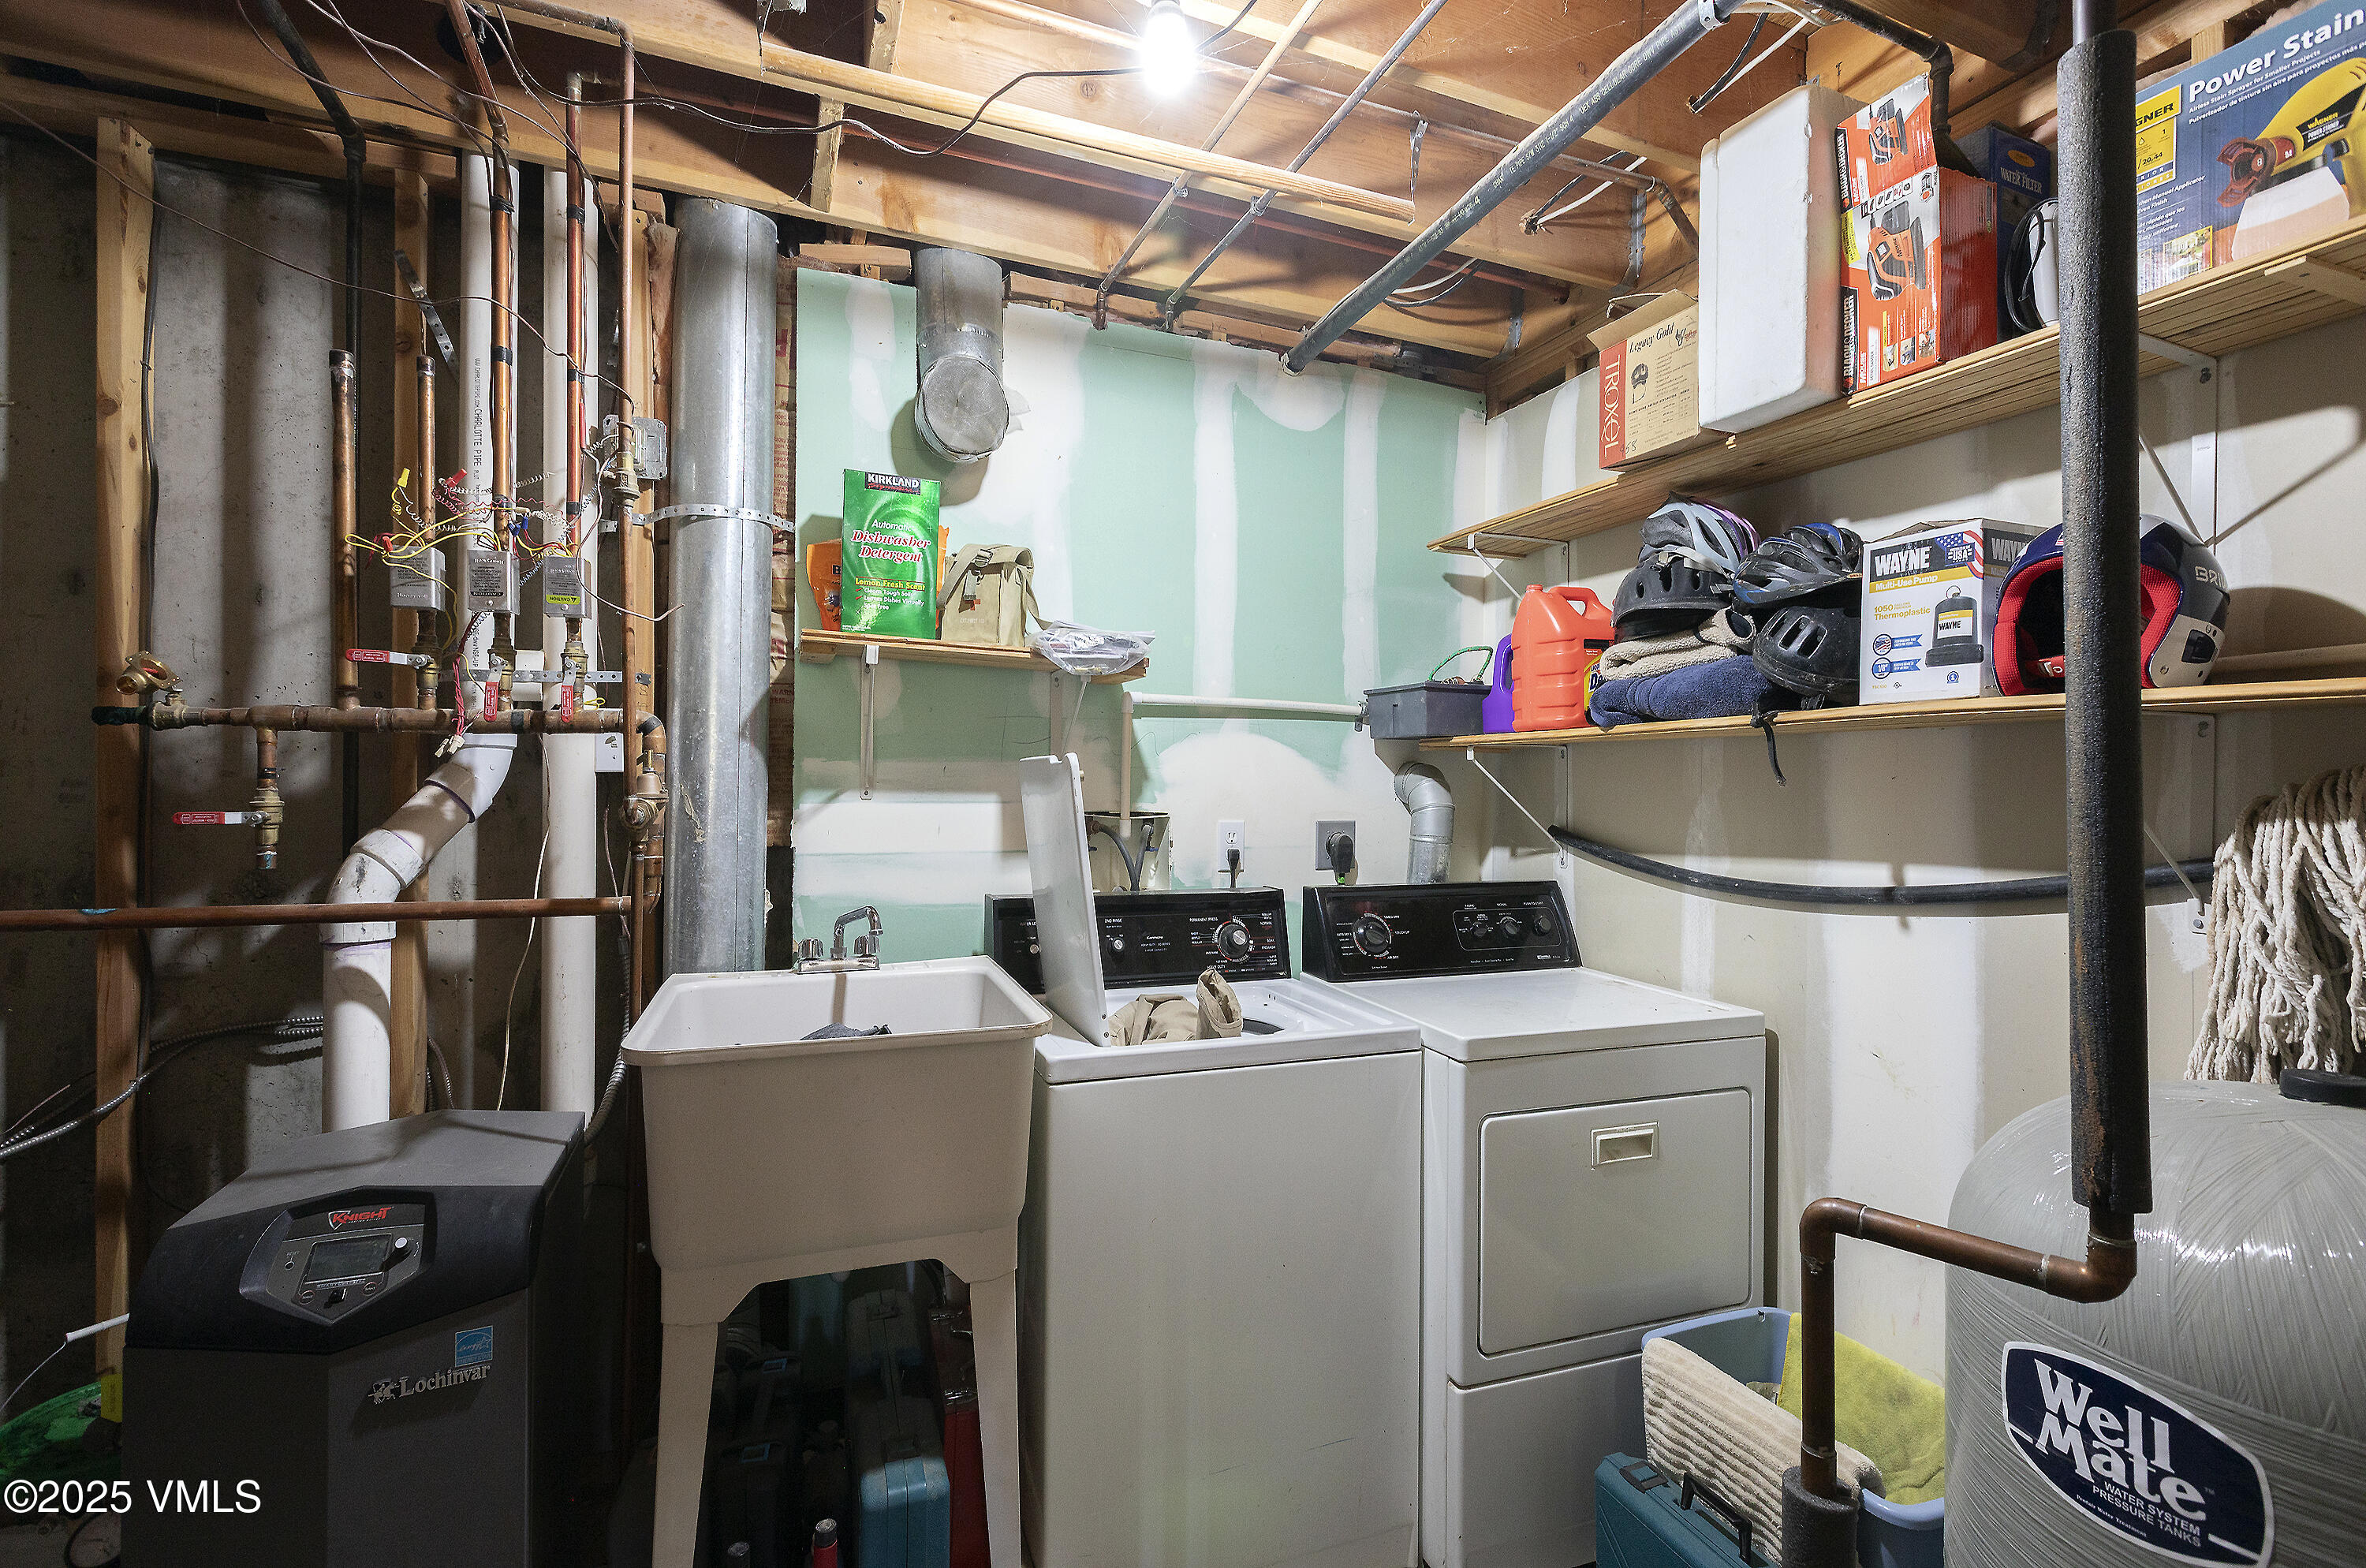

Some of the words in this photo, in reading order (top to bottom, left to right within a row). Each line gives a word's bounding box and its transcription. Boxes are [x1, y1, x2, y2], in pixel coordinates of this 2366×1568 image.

[2189, 50, 2276, 103] Power
[2283, 9, 2364, 58] Stain
[1601, 70, 1629, 96] CELLULAR
[1628, 58, 1643, 74] CORE
[2189, 101, 2210, 114] Airless
[2211, 93, 2228, 104] Stain
[2228, 81, 2253, 96] Sprayer
[2254, 76, 2264, 84] for
[2264, 63, 2292, 80] Smaller
[2292, 50, 2321, 67] Projects
[2189, 103, 2229, 125] Pulverizador
[2237, 88, 2262, 103] tintura
[2262, 83, 2273, 91] sin
[2272, 77, 2287, 87] aire
[2287, 69, 2304, 80] para
[2303, 52, 2342, 73] proyectos
[2342, 44, 2358, 57] más
[2000, 166, 2020, 185] WATER
[2022, 176, 2043, 195] FILTER
[2151, 186, 2174, 202] Manual
[2174, 174, 2207, 192] Applicator
[2151, 198, 2169, 210] Finish
[1629, 335, 1655, 354] Legacy
[1656, 322, 1675, 341] Gold
[473, 409, 483, 446] CHARLOTTE
[473, 450, 482, 467] PIPE
[868, 473, 920, 488] KIRKLAND
[851, 529, 931, 549] Dishwasher
[871, 519, 912, 532] Automatic
[859, 545, 924, 563] Detergent
[1874, 546, 1931, 577] WAYNE
[1953, 549, 1969, 561] USA
[855, 577, 881, 588] Lemon
[883, 580, 904, 588] Fresh
[906, 582, 926, 591] Scent
[1875, 579, 1913, 592] Multi-Use
[1913, 575, 1939, 585] Pump
[902, 598, 925, 607] Virtually
[1874, 604, 1894, 614] 1050
[1874, 607, 1931, 621] Thermoplastic
[1939, 621, 1961, 631] WAYNE
[332, 1208, 392, 1223] KNIGHT
[399, 1365, 491, 1398] Lochinvar
[2034, 1358, 2175, 1473] Well
[2035, 1411, 2207, 1521] Mate
[2076, 1494, 2096, 1510] Pentair
[2097, 1506, 2114, 1520] Water
[2115, 1517, 2148, 1537] Treatment
[2092, 1485, 2155, 1525] PRESSURE
[2158, 1519, 2202, 1547] TANKS
[2104, 1481, 2145, 1510] WATER
[2148, 1503, 2200, 1536] SYSTEM
